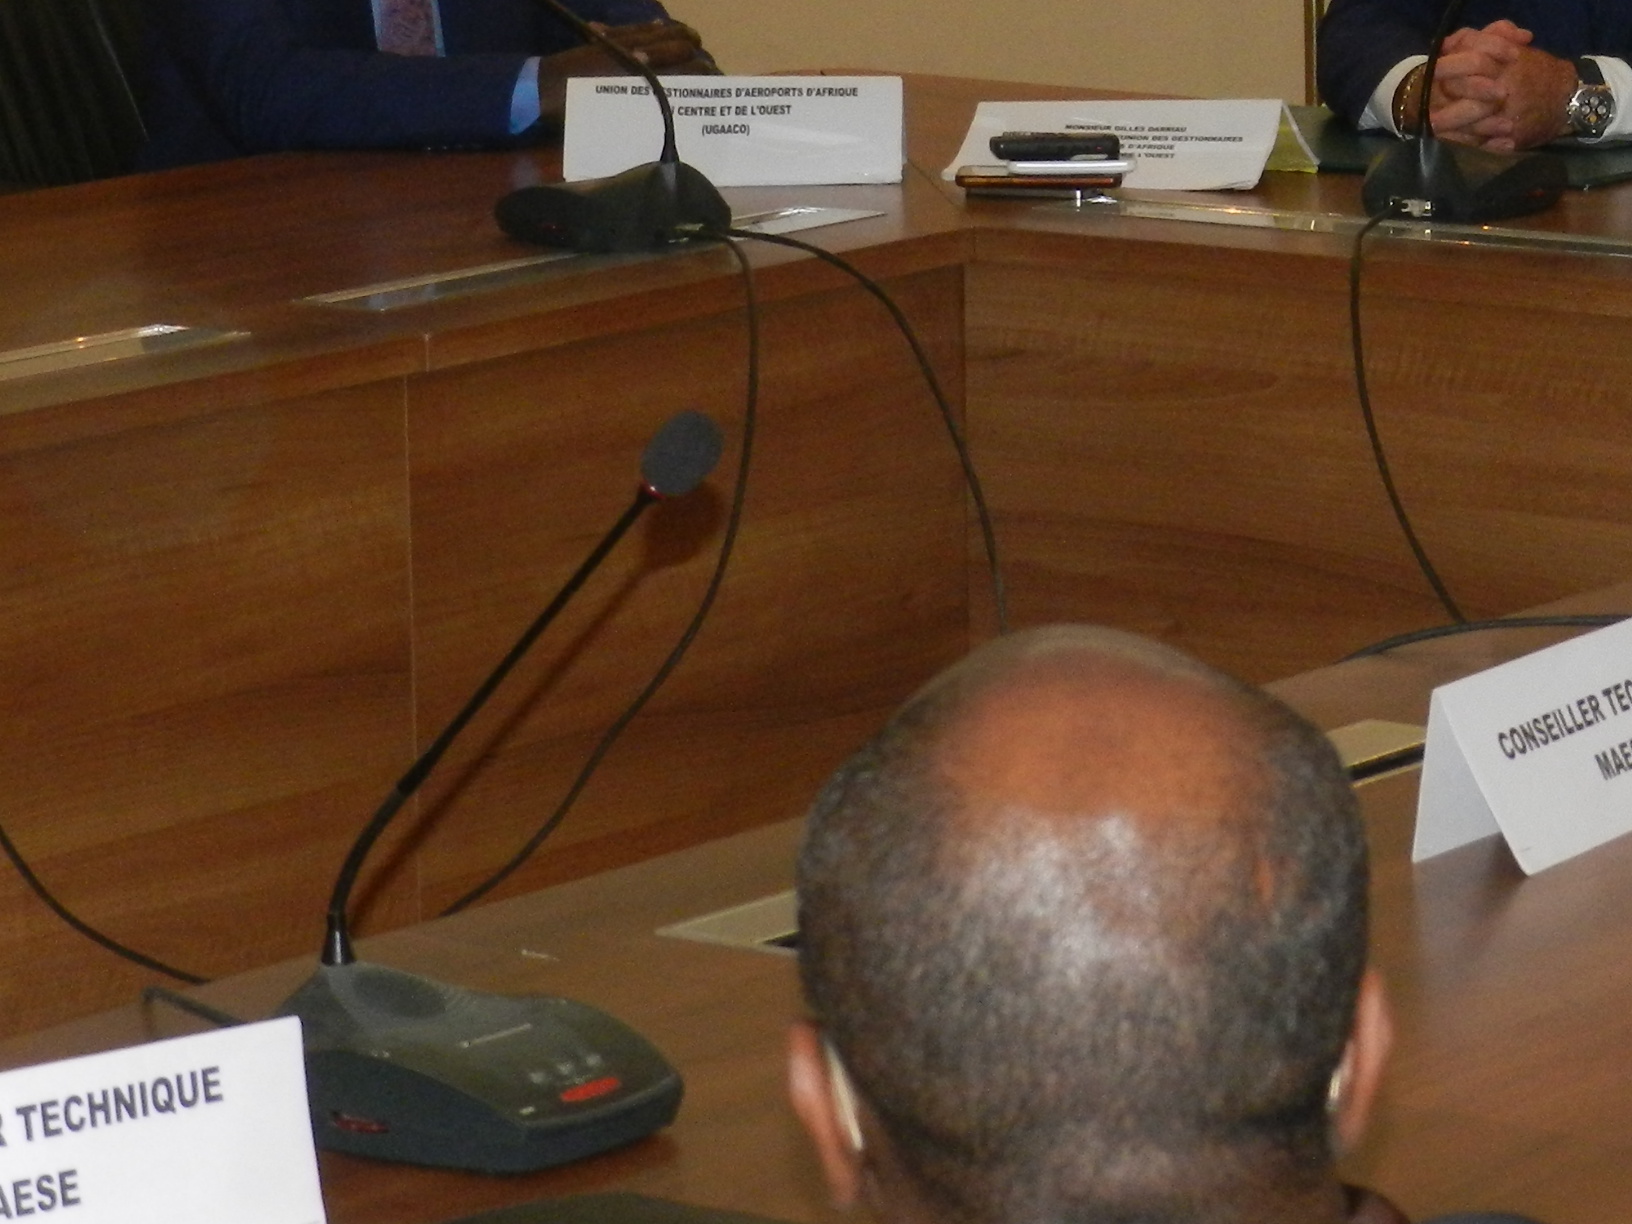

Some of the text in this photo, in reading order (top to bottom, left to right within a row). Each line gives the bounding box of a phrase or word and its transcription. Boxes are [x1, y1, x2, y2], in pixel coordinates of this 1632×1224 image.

[595, 85, 858, 98] UNION DES STIONNAIRES D'AEROPORTS D'AFRIQUE
[677, 106, 717, 116] CENTRE
[720, 106, 732, 116] ET
[735, 106, 748, 116] DE
[751, 105, 791, 116] L'OUEST
[702, 124, 750, 136] (UGAACO)
[1498, 694, 1605, 759] CONSEILLER
[15, 1065, 224, 1142] TECHNIQUE
[0, 1169, 81, 1219] AESE
